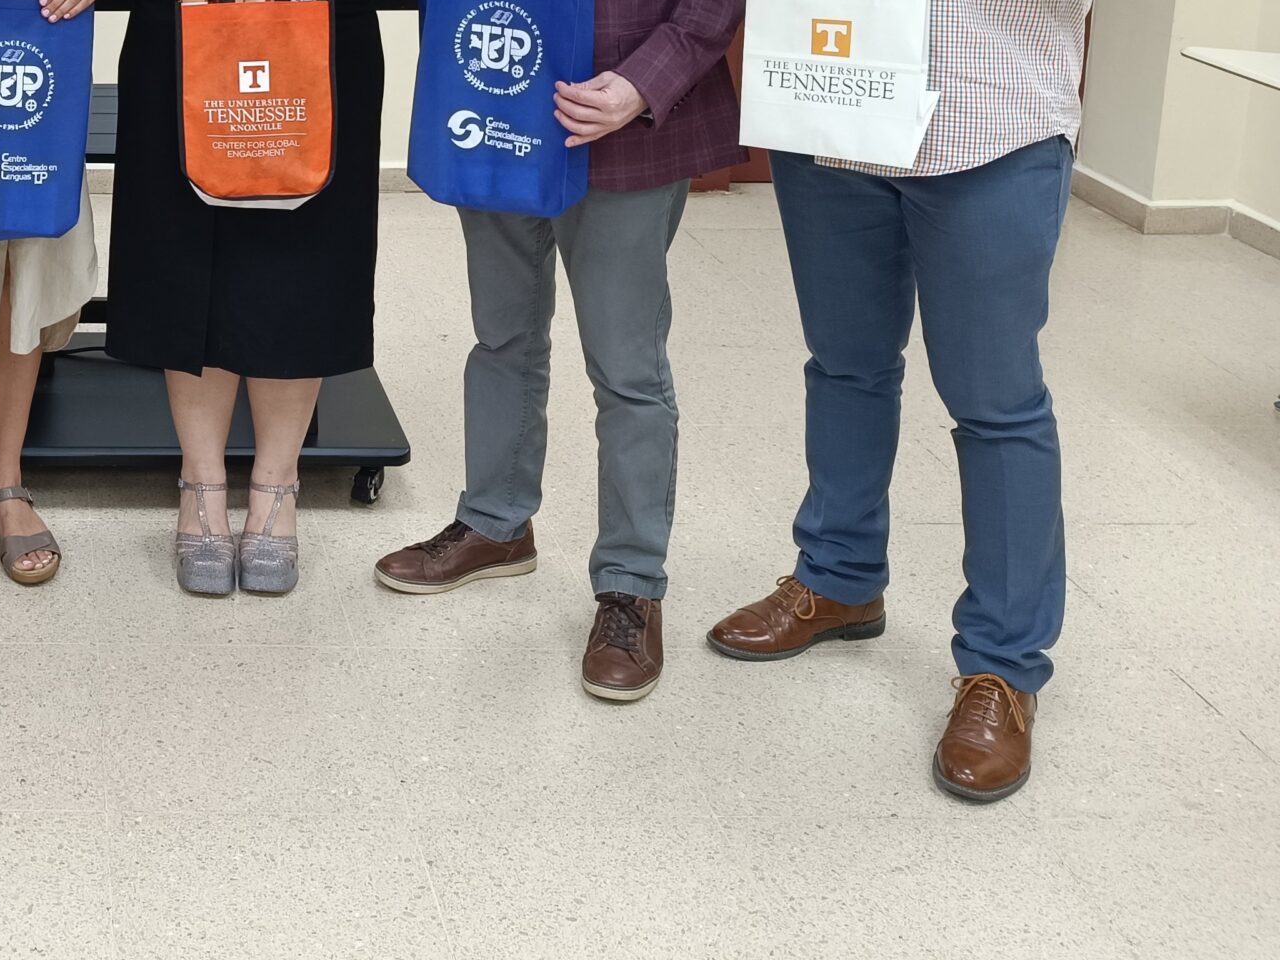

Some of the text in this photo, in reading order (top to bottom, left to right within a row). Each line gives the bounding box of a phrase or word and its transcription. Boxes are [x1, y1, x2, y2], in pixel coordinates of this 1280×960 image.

[454, 9, 477, 64] UNIVERSIDAD
[816, 23, 848, 53] T
[243, 65, 265, 88] T
[764, 60, 896, 80] THE UNIVERSITY OF
[763, 70, 895, 100] TENNESSEE
[228, 98, 289, 107] UNIVERSITY
[794, 92, 862, 107] KNOXVILLE
[204, 107, 307, 123] TENNESSEE
[230, 123, 282, 132] KNOXVILLE
[486, 117, 509, 129] Centro
[212, 141, 245, 149] CENTER
[268, 140, 300, 148] GLOBAL
[485, 135, 513, 149] Lenguas
[2, 153, 27, 162] Centro
[228, 148, 285, 158] ENGAGEMENT
[1, 171, 31, 182] Lenguas
